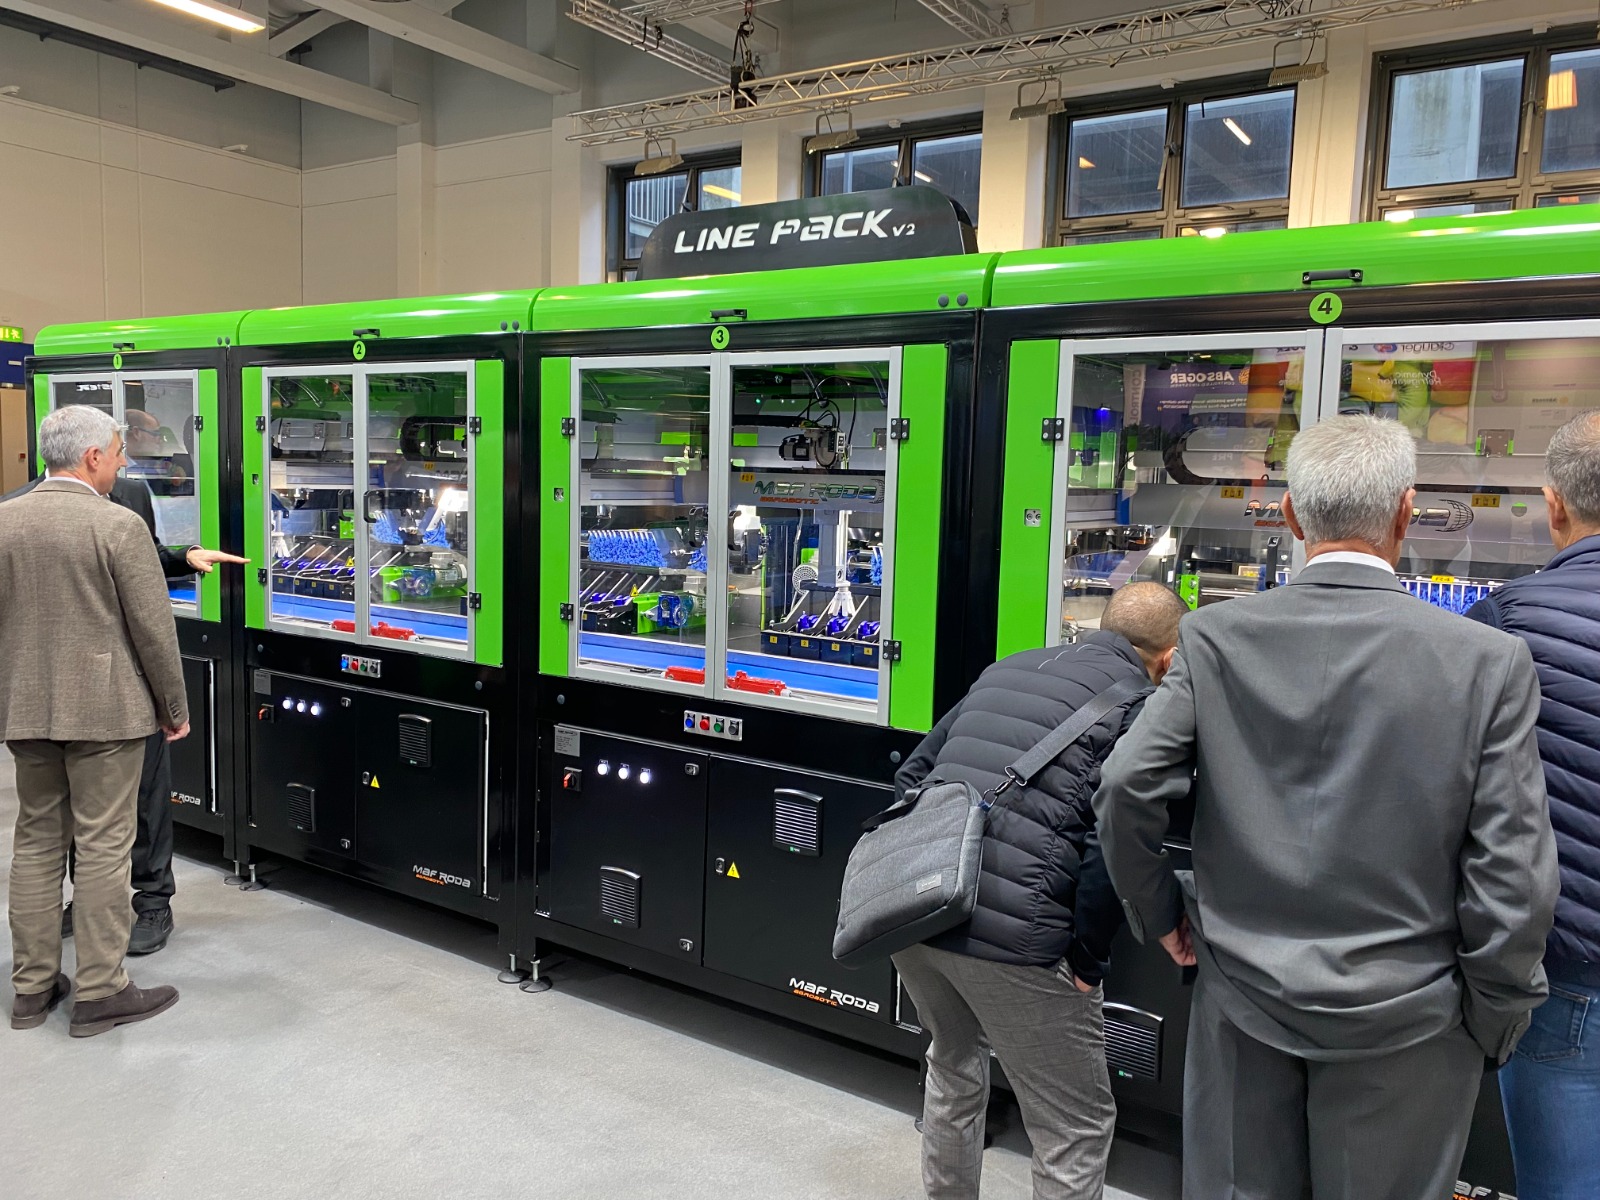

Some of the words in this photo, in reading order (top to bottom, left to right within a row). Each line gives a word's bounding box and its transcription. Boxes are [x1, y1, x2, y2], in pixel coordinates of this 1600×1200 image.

[674, 223, 760, 253] LINE
[1317, 297, 1333, 315] 4
[715, 329, 724, 344] 3
[356, 343, 363, 355] 2
